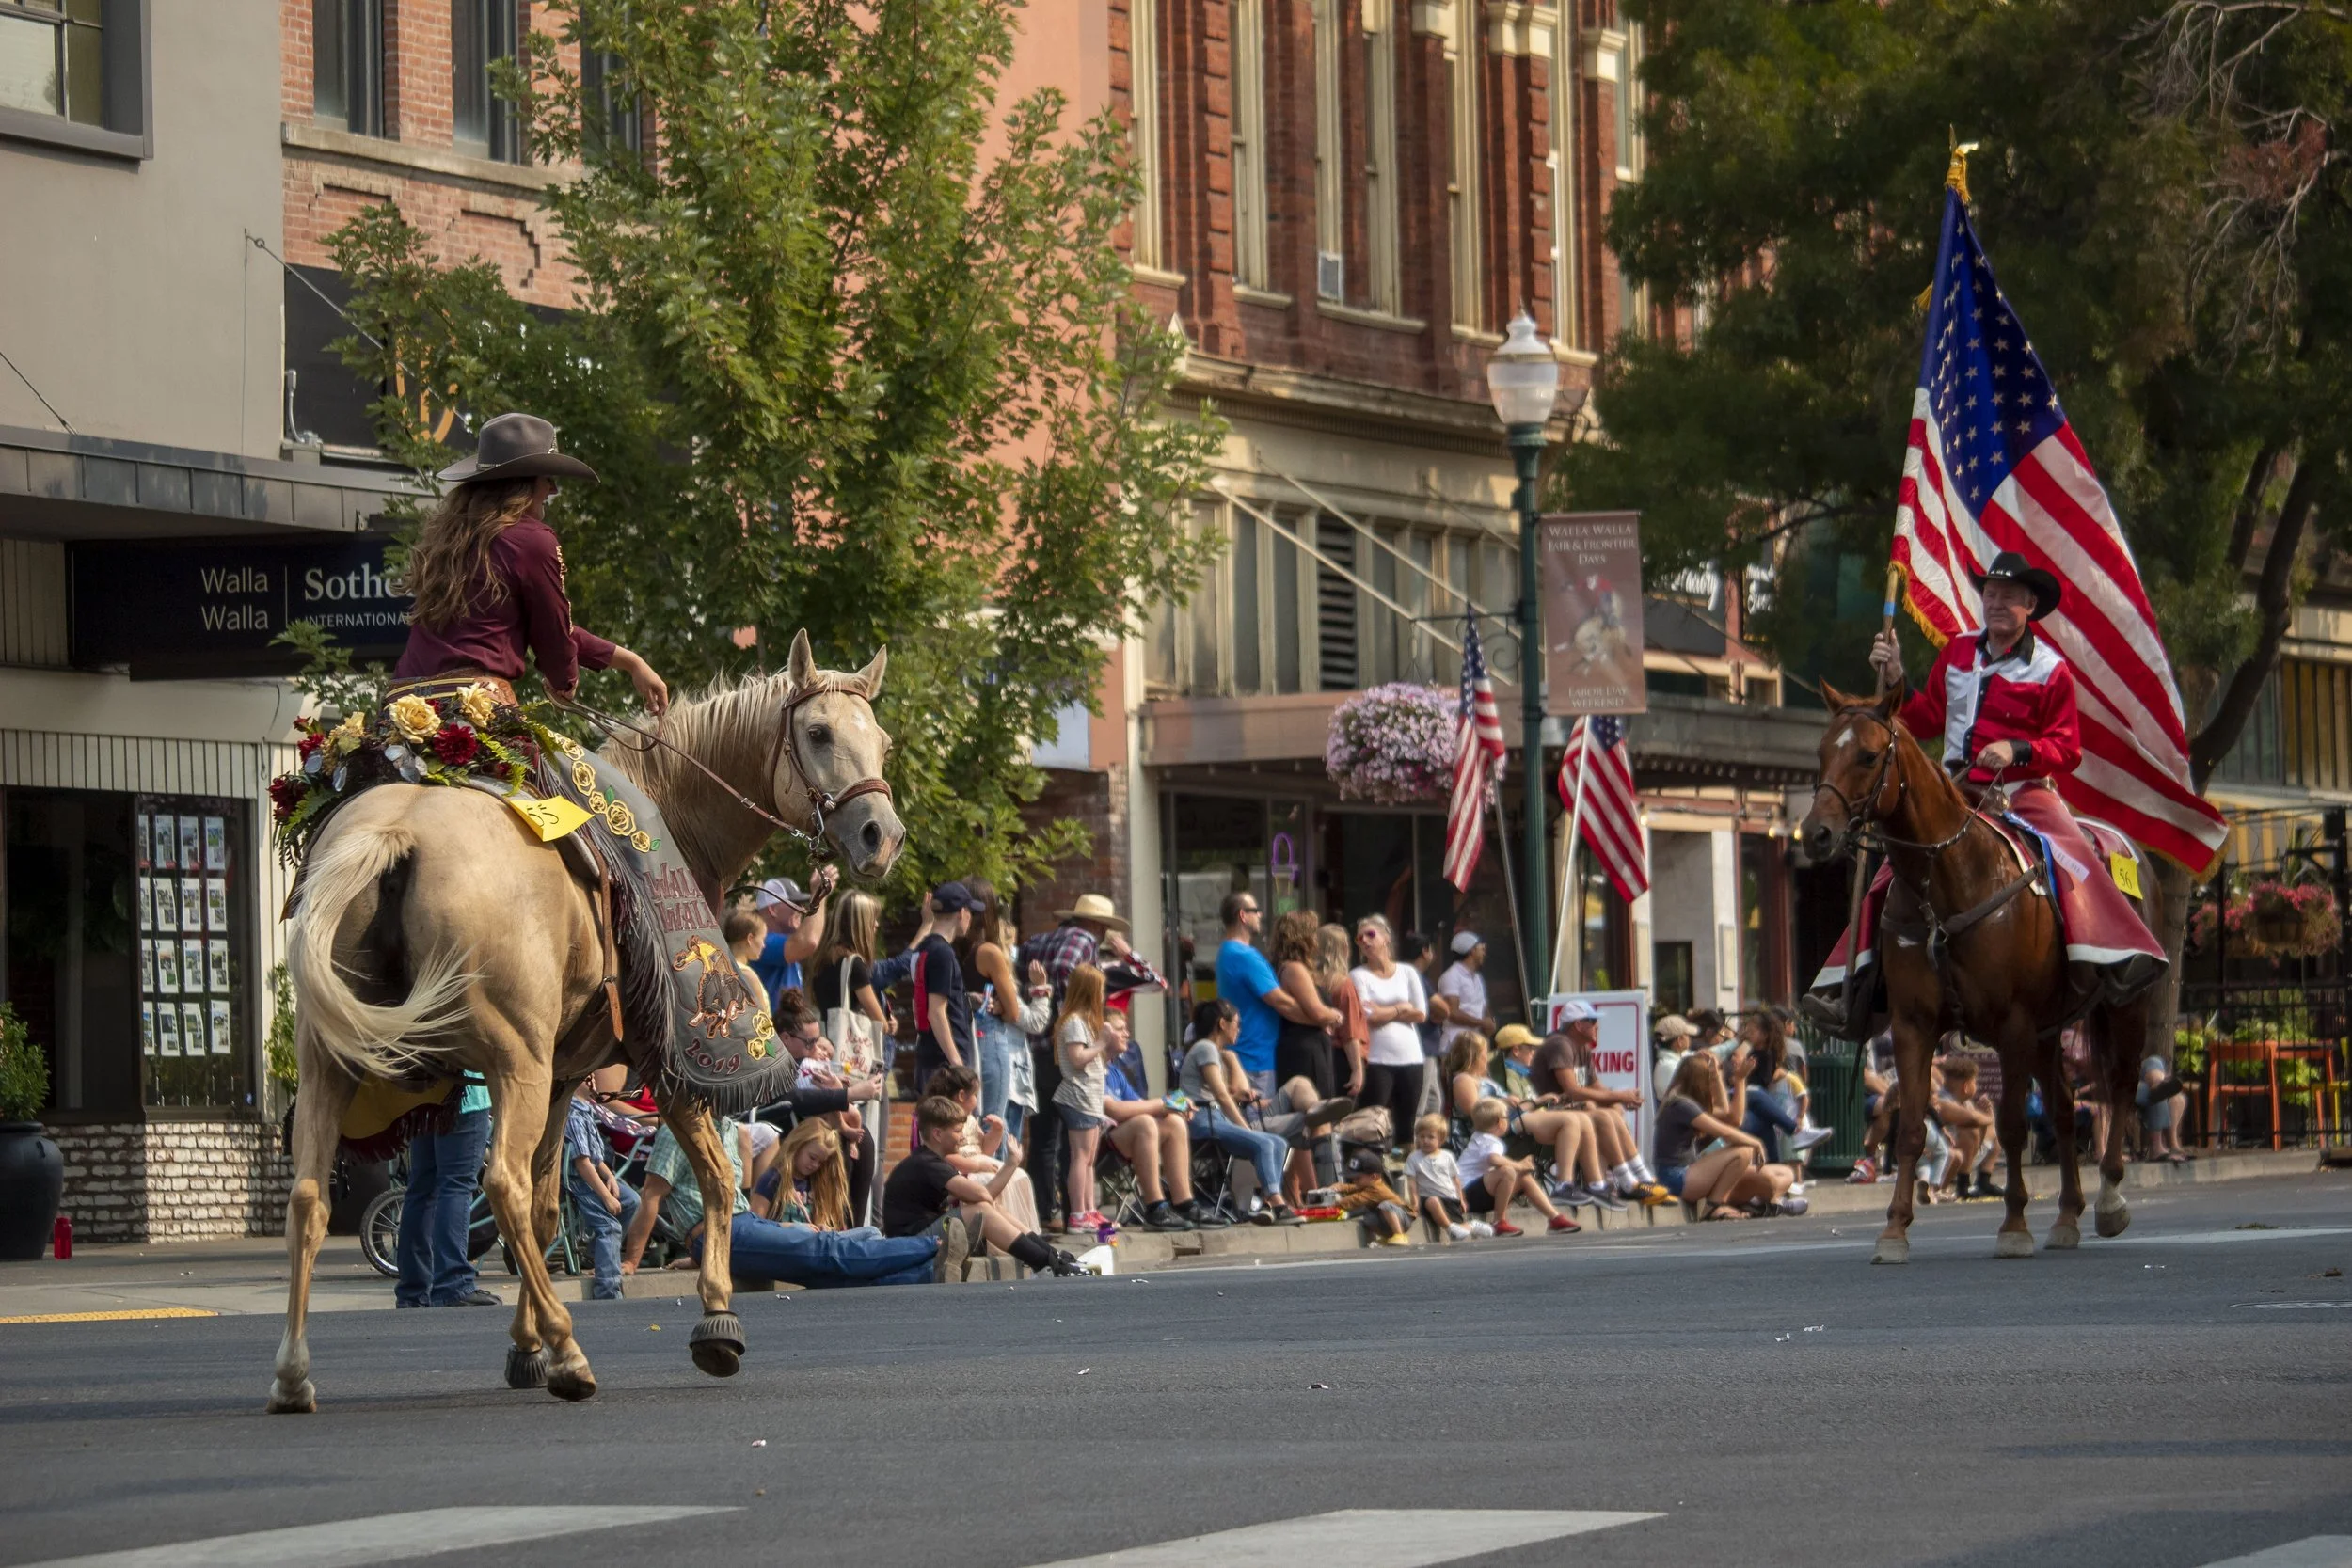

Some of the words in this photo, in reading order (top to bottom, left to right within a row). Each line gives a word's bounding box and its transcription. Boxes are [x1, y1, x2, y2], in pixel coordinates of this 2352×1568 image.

[1549, 526, 1588, 537] WALLA
[1592, 523, 1632, 535] WALLA
[1548, 541, 1572, 553] FAIR
[1584, 539, 1637, 551] FRONTIER
[1579, 553, 1607, 565] DAYS
[200, 566, 269, 594] Walla
[200, 605, 269, 632] Walla
[2119, 868, 2133, 889] 56
[685, 1037, 741, 1075] 2019
[1591, 1051, 1635, 1073] KING
